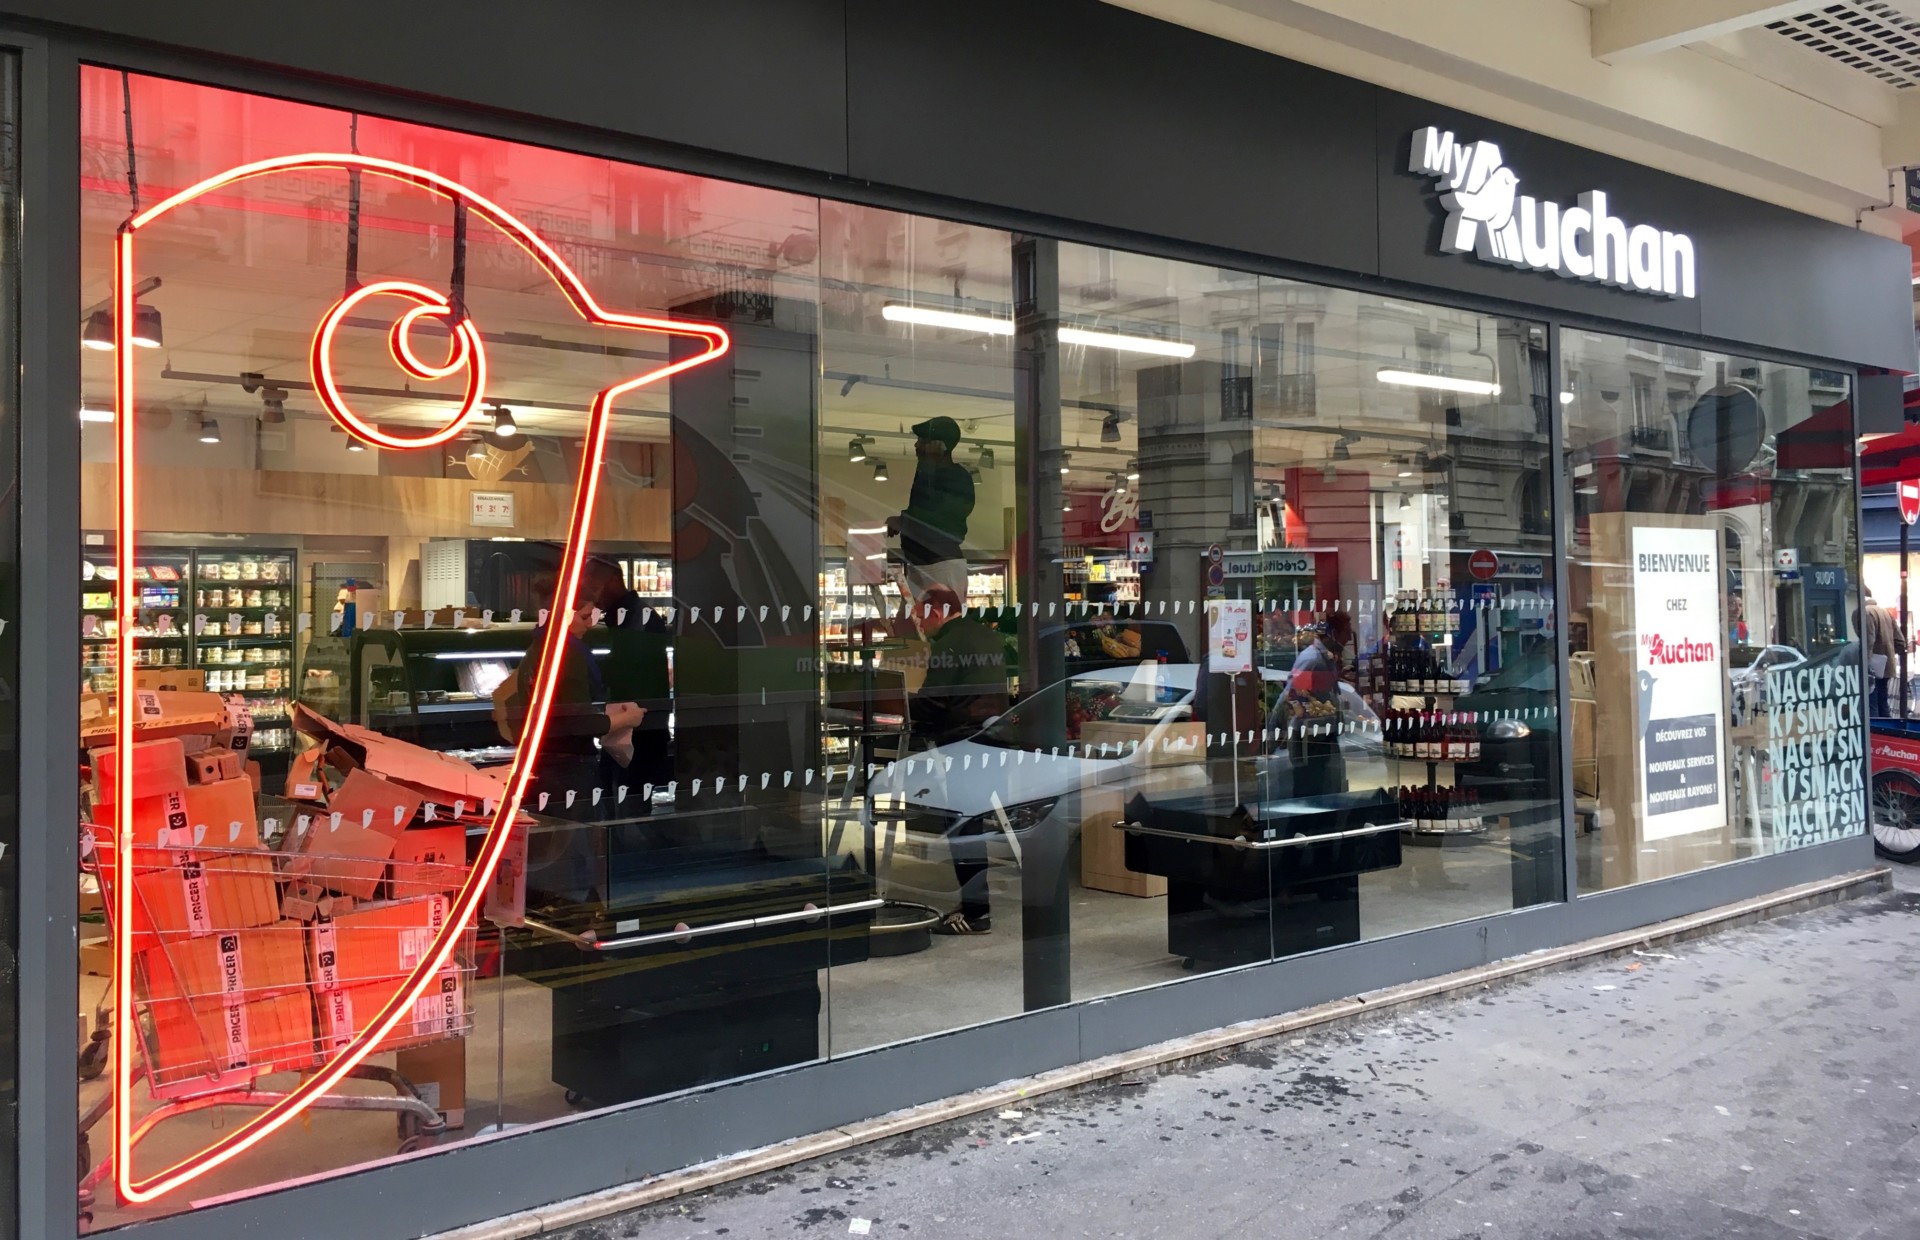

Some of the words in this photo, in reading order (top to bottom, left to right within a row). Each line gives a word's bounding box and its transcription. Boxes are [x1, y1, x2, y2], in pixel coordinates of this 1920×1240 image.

[1422, 125, 1473, 190] My
[1454, 139, 1696, 299] Auchan
[1638, 553, 1710, 573] BIENVENUE
[1666, 599, 1687, 611] CHEZ
[1641, 633, 1654, 650] My
[1649, 633, 1714, 665] Auchan
[1796, 695, 1861, 734] SNACK
[1655, 728, 1693, 743] DÉCOUVREZ
[1694, 727, 1707, 738] VOS
[1649, 758, 1686, 773] NOUVEAUX
[1687, 755, 1715, 768] SERVICES
[1680, 773, 1686, 784] &
[1799, 758, 1865, 801] SNACK
[1649, 788, 1686, 804] NOUVEAUX
[1687, 784, 1713, 797] RAYONS
